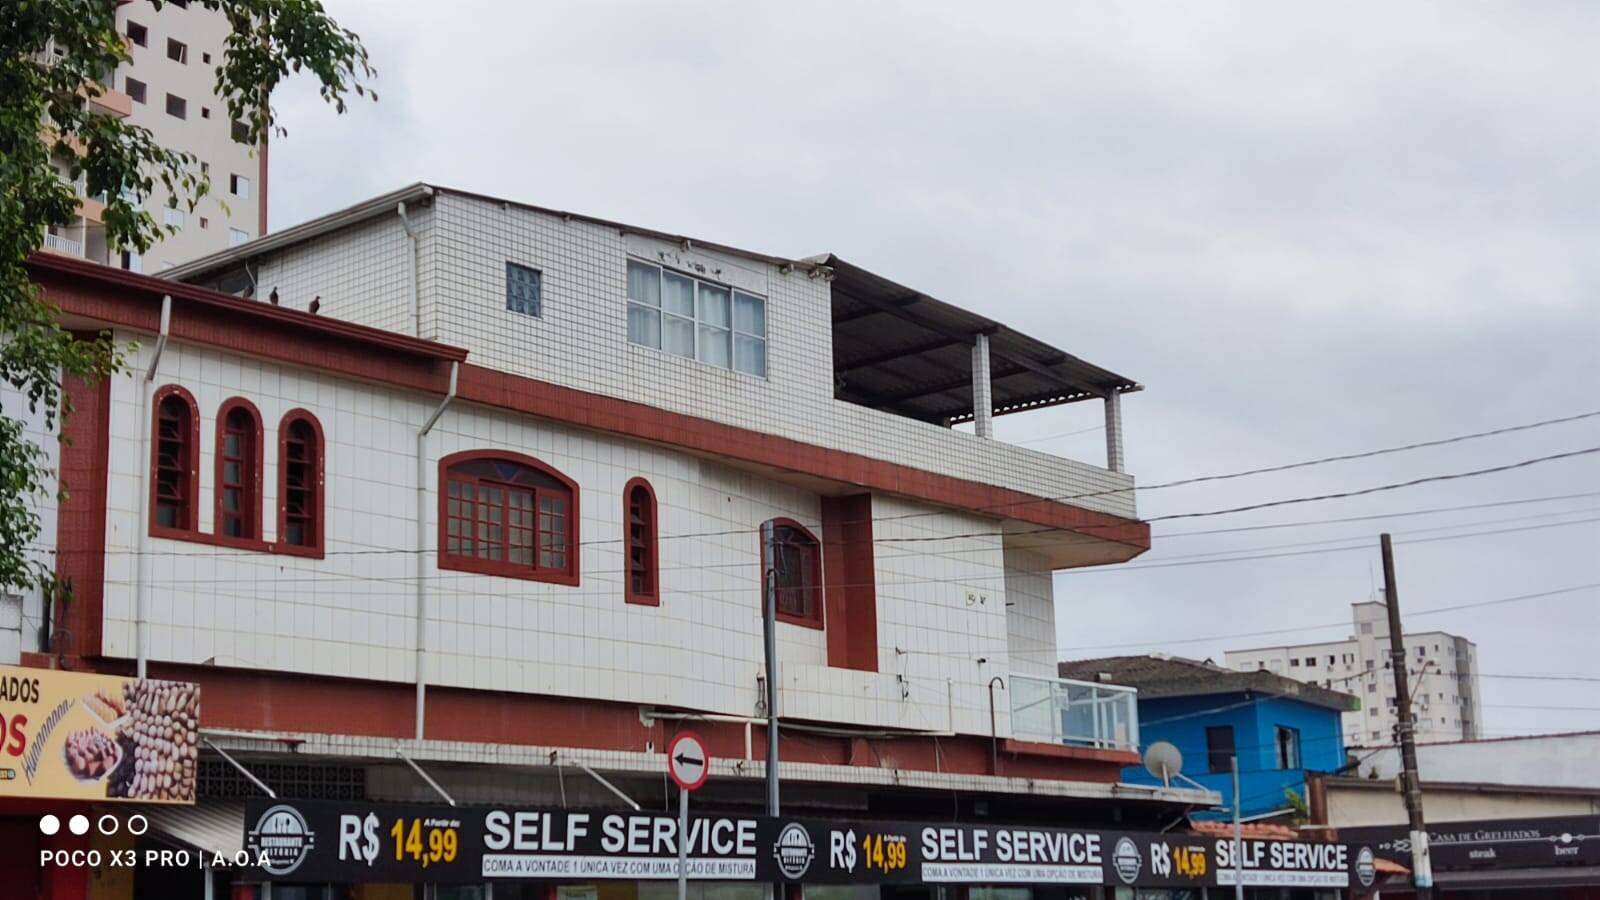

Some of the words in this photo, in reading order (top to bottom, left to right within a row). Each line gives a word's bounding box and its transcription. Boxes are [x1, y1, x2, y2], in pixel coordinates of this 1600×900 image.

[0, 713, 28, 757] S
[338, 811, 380, 867] R$
[390, 818, 458, 868] 14,99
[483, 810, 590, 851] SELF
[600, 814, 757, 855] SERVICE
[830, 828, 857, 874] R$
[863, 833, 907, 874] 14,99
[921, 827, 988, 861] SELF
[996, 829, 1102, 864] SERVICE
[1555, 845, 1579, 856] beer
[484, 859, 513, 872] COMA
[525, 859, 569, 873] VONTADE
[611, 861, 628, 873] VEZ
[630, 861, 650, 874] COM
[653, 862, 671, 874] UMA
[673, 858, 703, 875] OÇÃO
[719, 863, 754, 875] MISTURA
[1150, 841, 1171, 879] R$
[1215, 839, 1265, 868] SELF
[1270, 842, 1349, 870] SERVICE
[1469, 848, 1496, 859] steak
